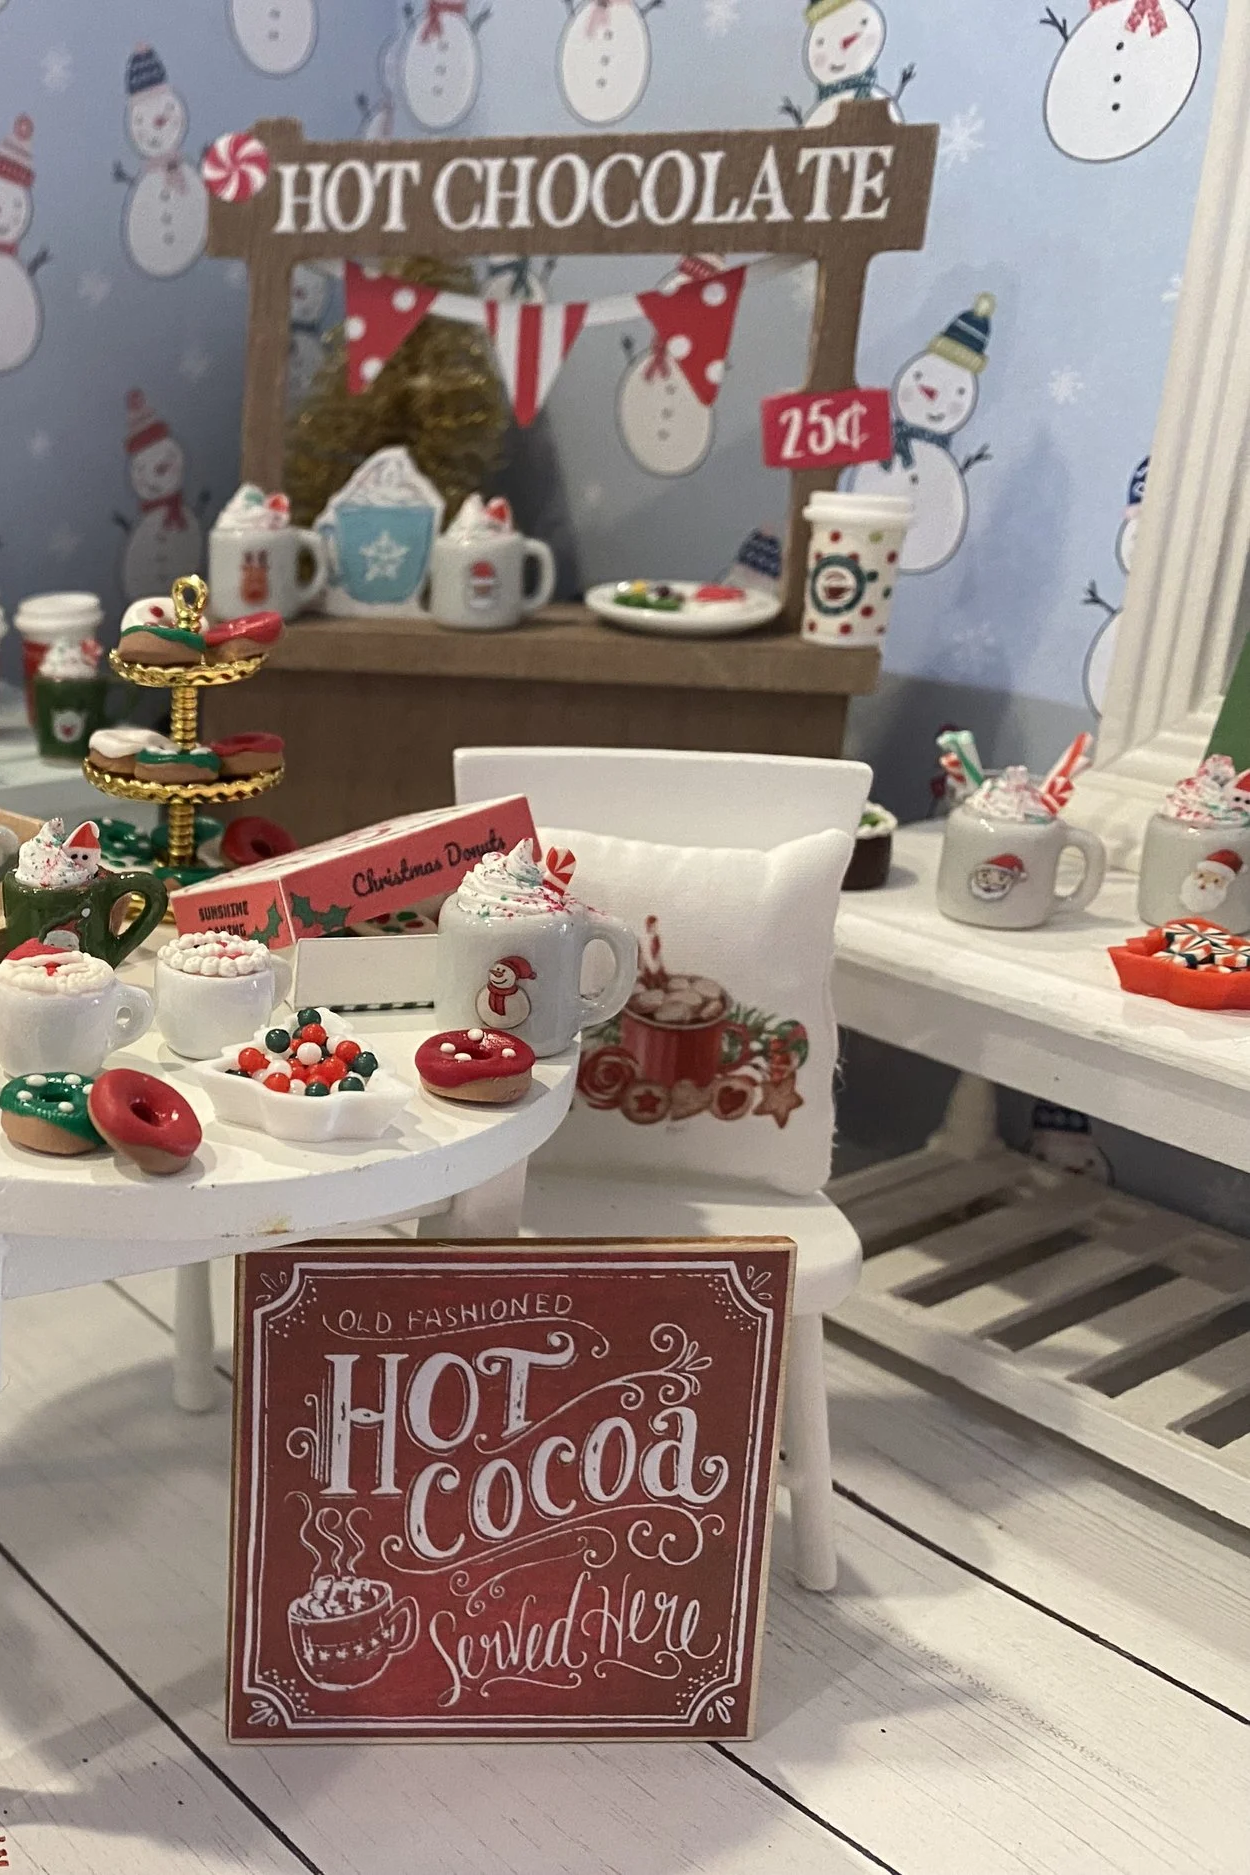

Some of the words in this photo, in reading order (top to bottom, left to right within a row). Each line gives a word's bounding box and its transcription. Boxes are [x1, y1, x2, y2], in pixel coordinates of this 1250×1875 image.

[272, 158, 421, 234] HOT
[433, 145, 895, 228] CHOCOLATE
[778, 398, 871, 462] 25¢
[352, 858, 443, 897] Christmas
[444, 829, 506, 867] Donuts
[198, 900, 249, 922] SUNSHINE
[337, 1307, 393, 1337] OLD
[406, 1292, 574, 1331] FASHIONED
[317, 1330, 579, 1500] HOT
[581, 1572, 723, 1661] Here
